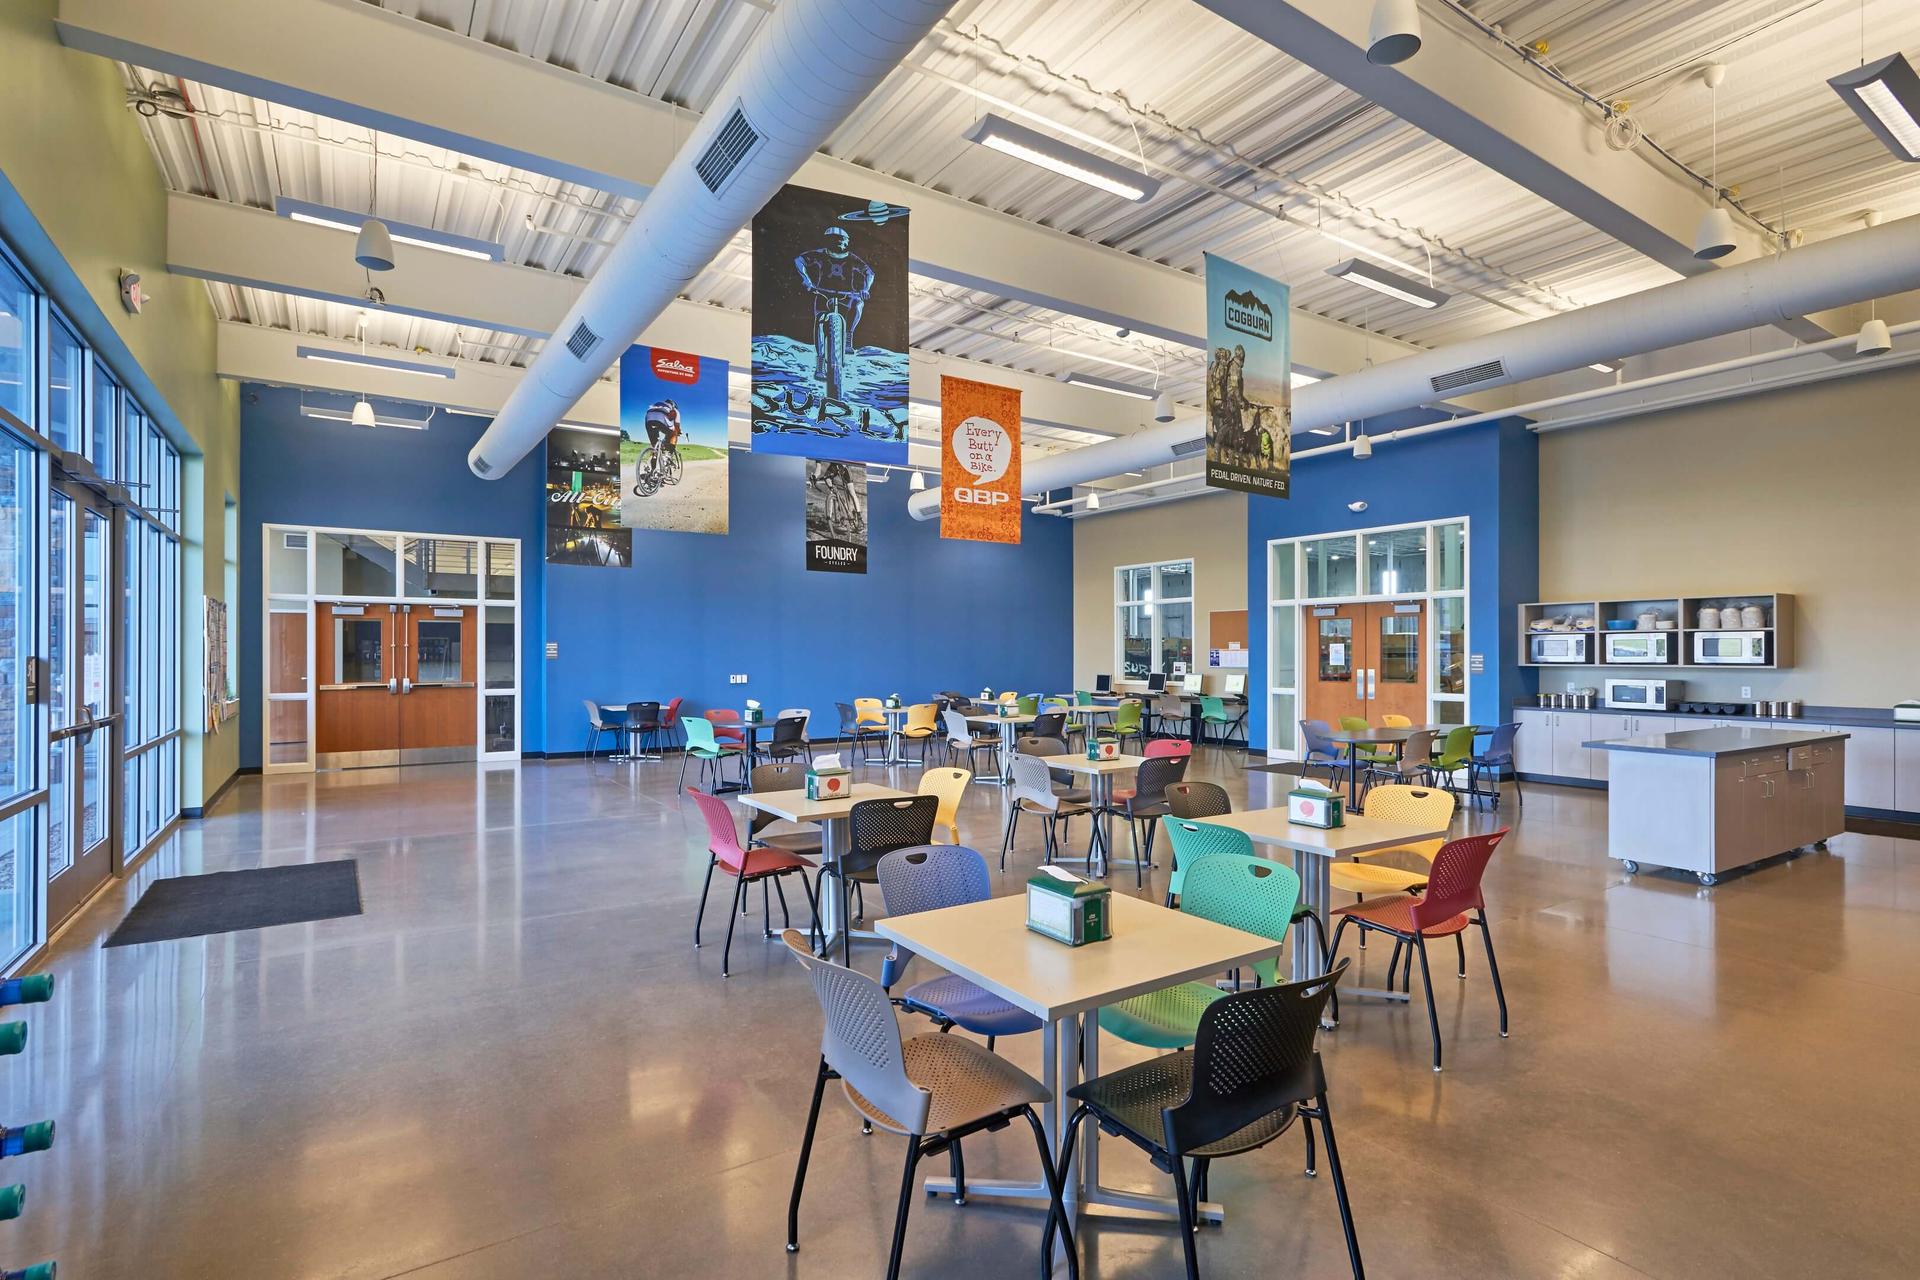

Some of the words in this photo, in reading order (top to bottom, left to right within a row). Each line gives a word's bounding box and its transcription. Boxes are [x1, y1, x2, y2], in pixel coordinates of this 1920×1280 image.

[1228, 307, 1270, 333] COGBURN
[656, 358, 695, 373] Salsa
[751, 386, 908, 441] SURLY
[965, 422, 1002, 446] Every
[968, 438, 994, 452] Butt
[969, 452, 983, 460] on
[985, 453, 992, 462] a
[970, 461, 997, 473] Bike.
[1211, 468, 1230, 481] PEDAL
[1252, 476, 1273, 489] NATURE
[1274, 480, 1286, 490] FED.
[953, 487, 1009, 506] QBP
[815, 545, 858, 562] FOUNDRY
